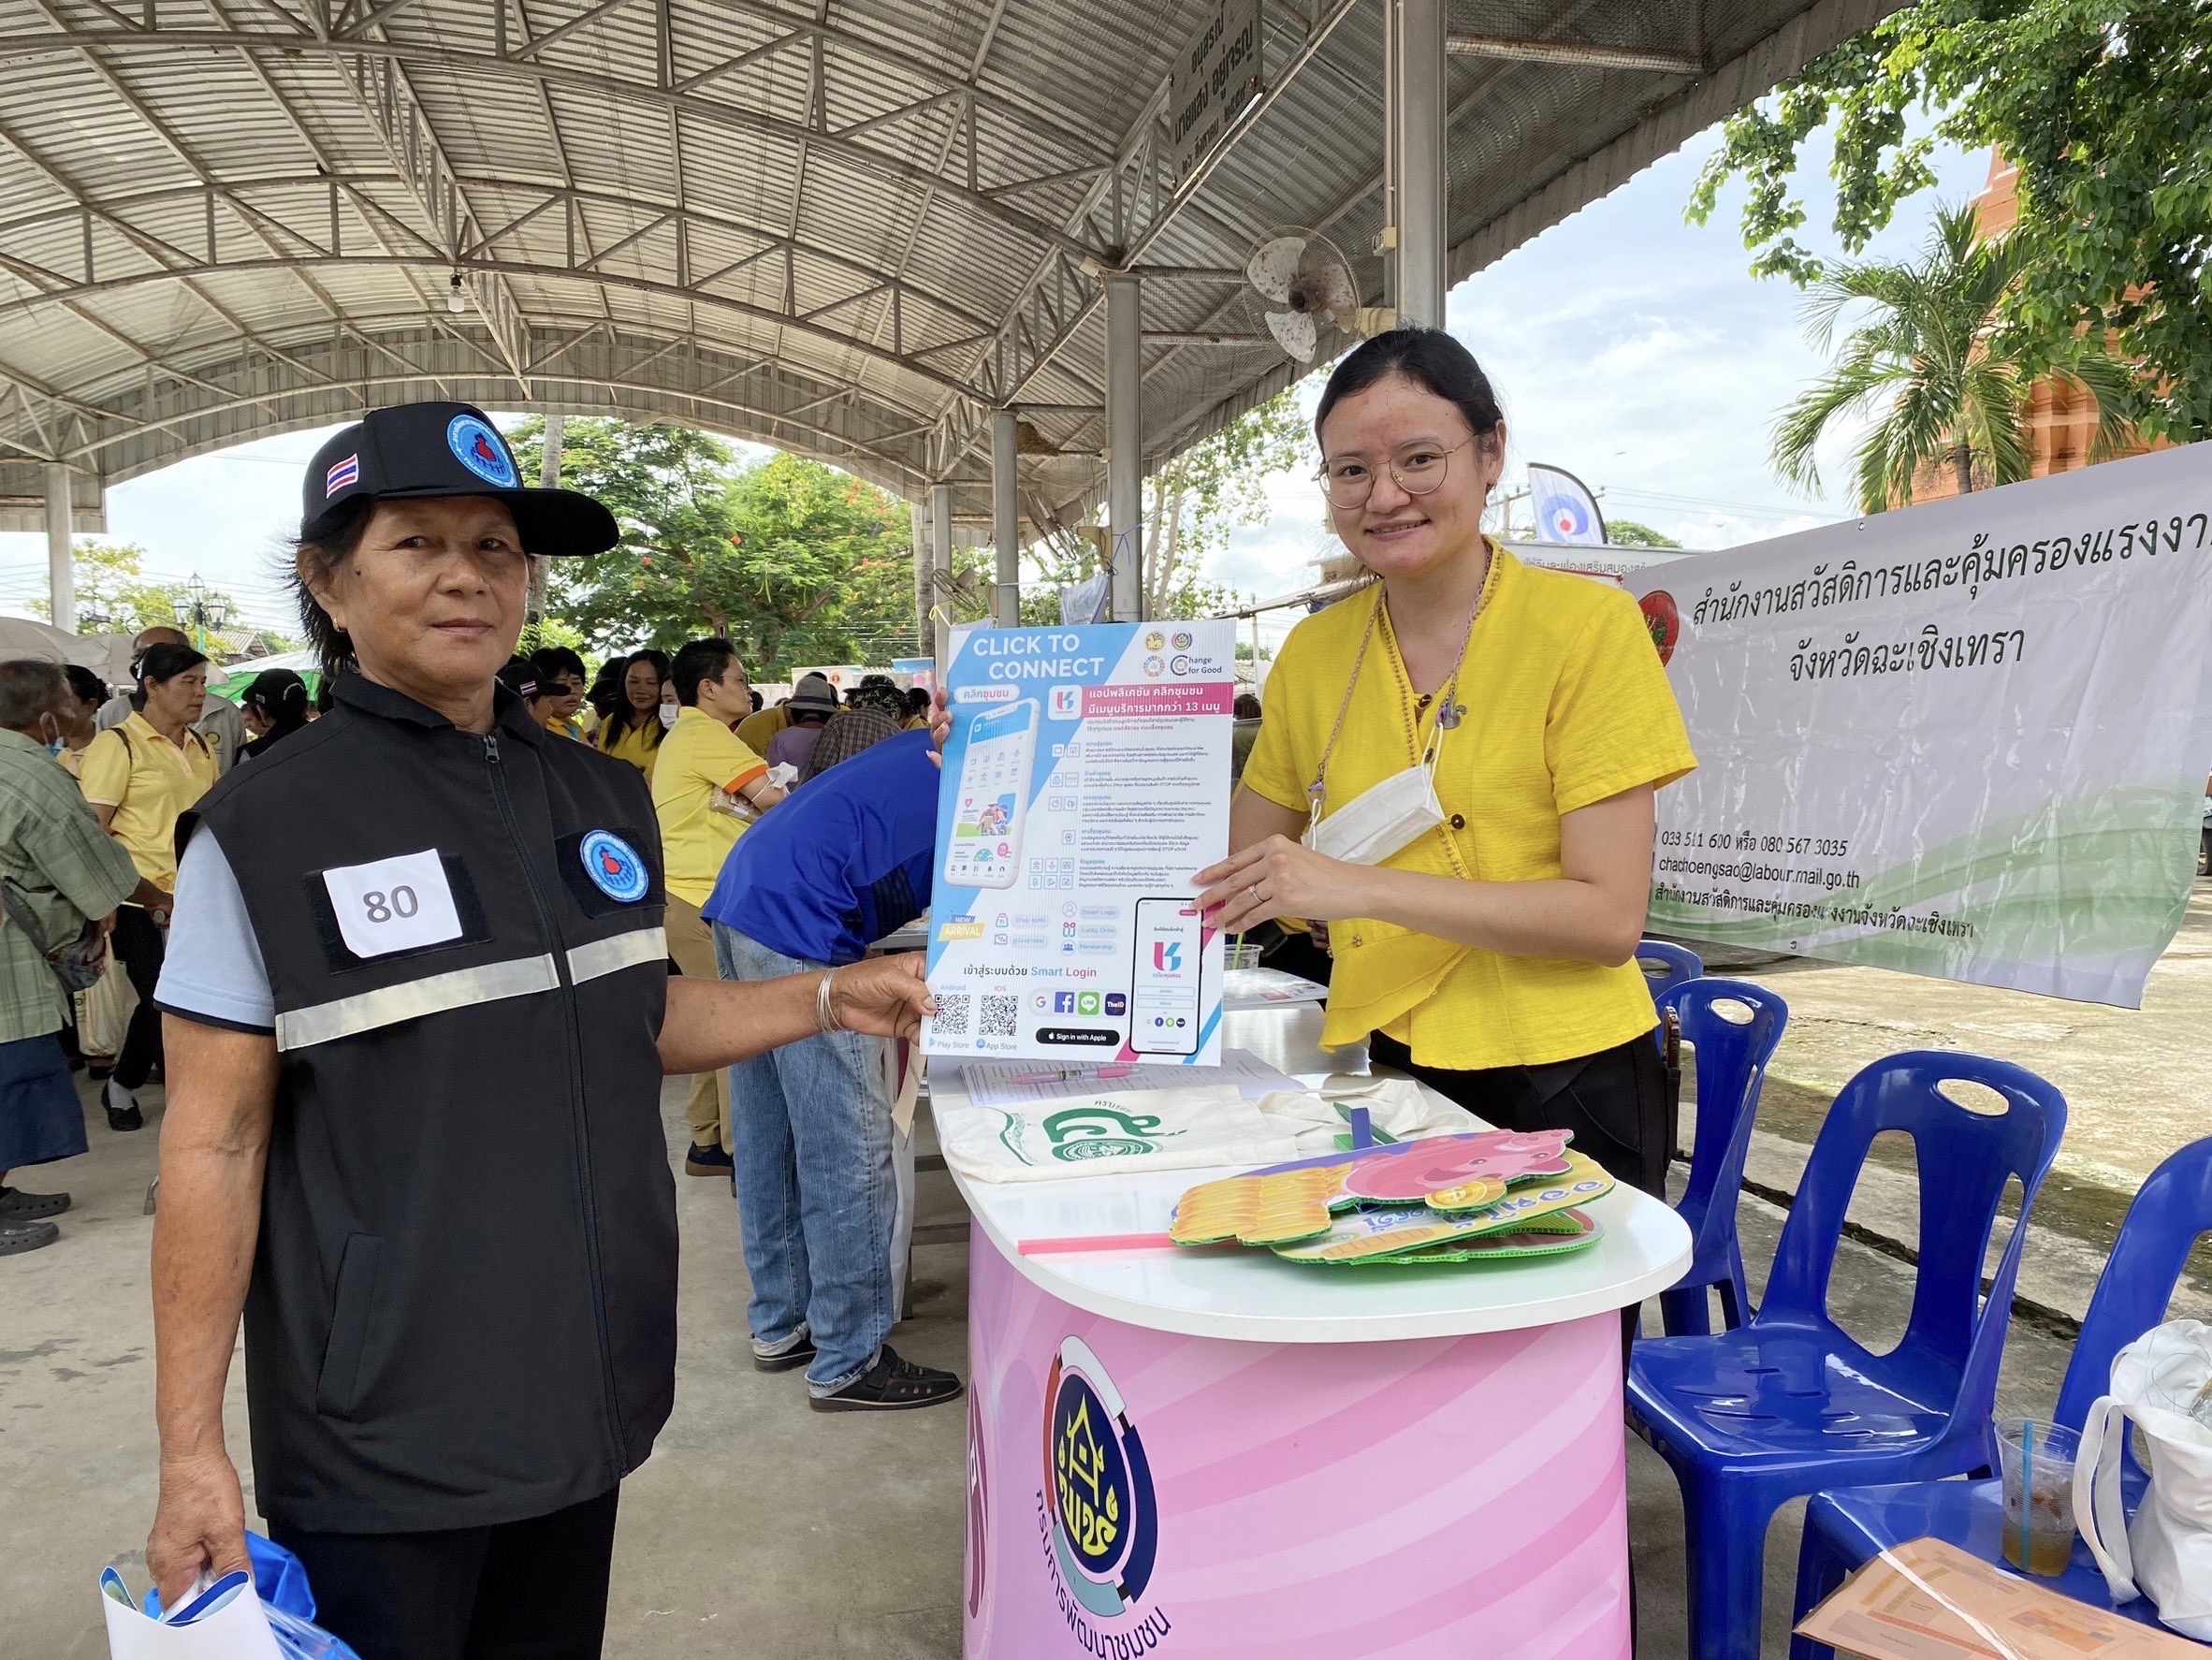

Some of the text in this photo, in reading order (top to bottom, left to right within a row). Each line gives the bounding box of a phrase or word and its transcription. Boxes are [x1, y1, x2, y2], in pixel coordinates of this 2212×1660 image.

[1694, 514, 2212, 625] สำนักงานสวัสดิการและคุ้มครองแรงงา
[973, 633, 1080, 657] CLICK TO
[1790, 624, 2025, 681] จังหวัดฉะเชิงเทรา
[989, 657, 1104, 680] CONNECT
[964, 689, 1010, 701] คลิกชุมชน
[1154, 686, 1203, 699] คลิกชุมชน
[1088, 702, 1220, 717] มีเมนูบริการมากกว่า 13 เมนู
[1661, 831, 1681, 846] 033
[1736, 830, 1756, 851] หรือ
[1761, 837, 1783, 852] 080
[1785, 837, 1812, 855] 567
[1814, 839, 1849, 857] 3035
[363, 885, 418, 924] 80
[945, 925, 981, 936] ARRIVAL
[964, 964, 1097, 979] เข้าสู่ระบบด้วย Smart Login
[1036, 1489, 1171, 1660] กรมการพัฒนาชมชน
